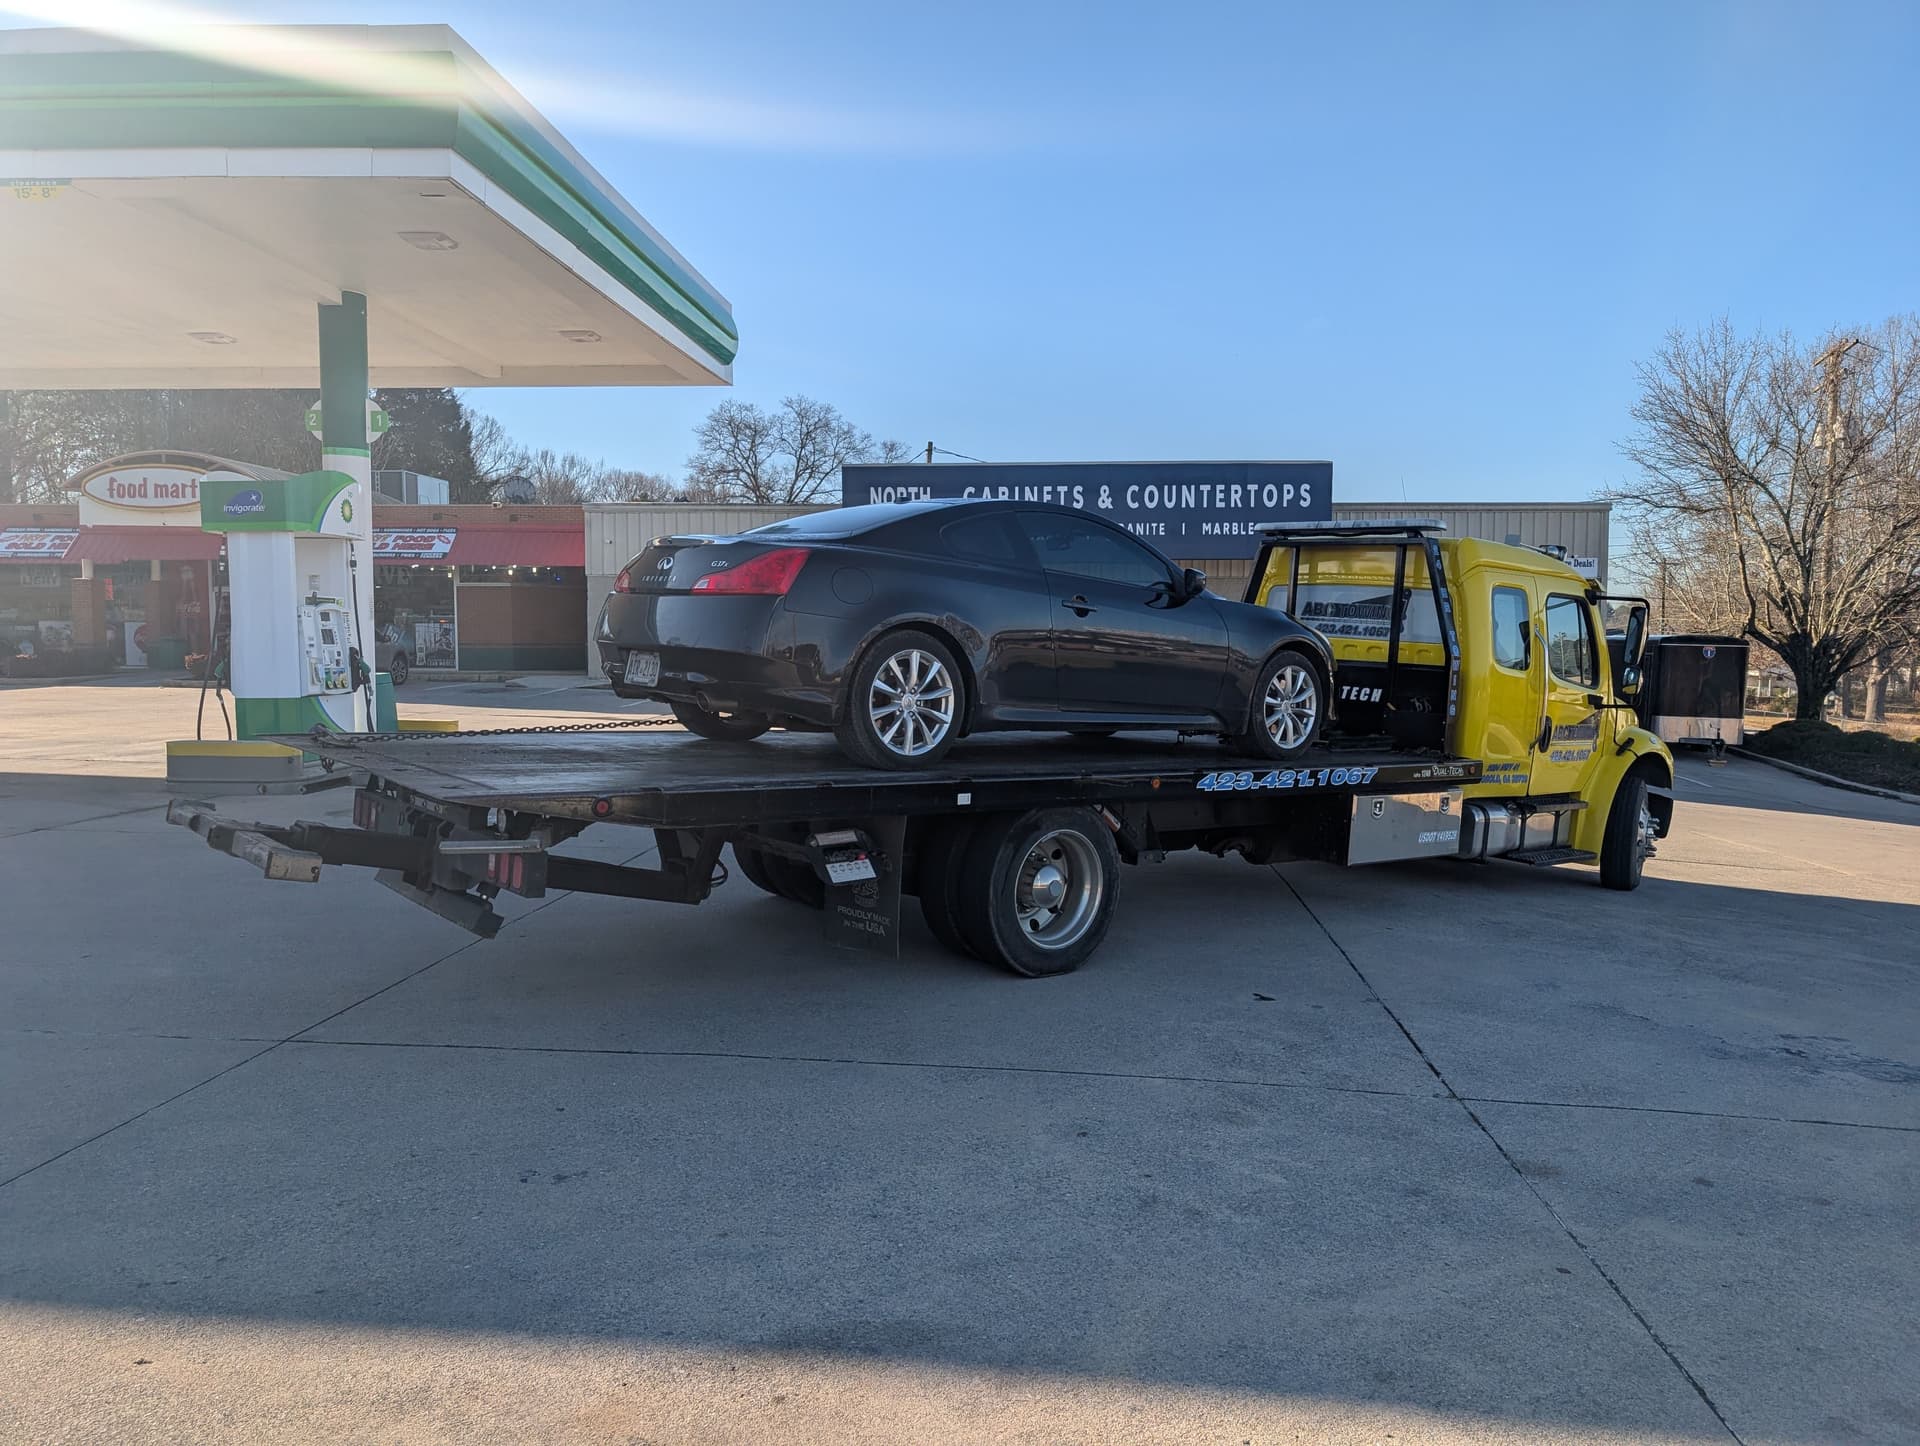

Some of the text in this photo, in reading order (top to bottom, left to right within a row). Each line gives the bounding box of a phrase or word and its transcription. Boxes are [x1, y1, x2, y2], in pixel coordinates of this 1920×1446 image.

[309, 413, 317, 426] 2
[376, 414, 382, 427] 1
[107, 476, 199, 499] food mart
[1097, 485, 1113, 509] &
[1126, 483, 1312, 509] COUNTERTOPS
[1118, 522, 1166, 536] ANITE
[1202, 521, 1255, 536] MARBLE
[373, 534, 390, 543] OT
[1573, 558, 1595, 568] Deals!
[1340, 603, 1393, 620] TOWIN
[1341, 685, 1383, 702] TECH
[1196, 768, 1379, 792] 423.421.1067
[838, 905, 872, 921] PROUDLY
[865, 921, 886, 936] USA
